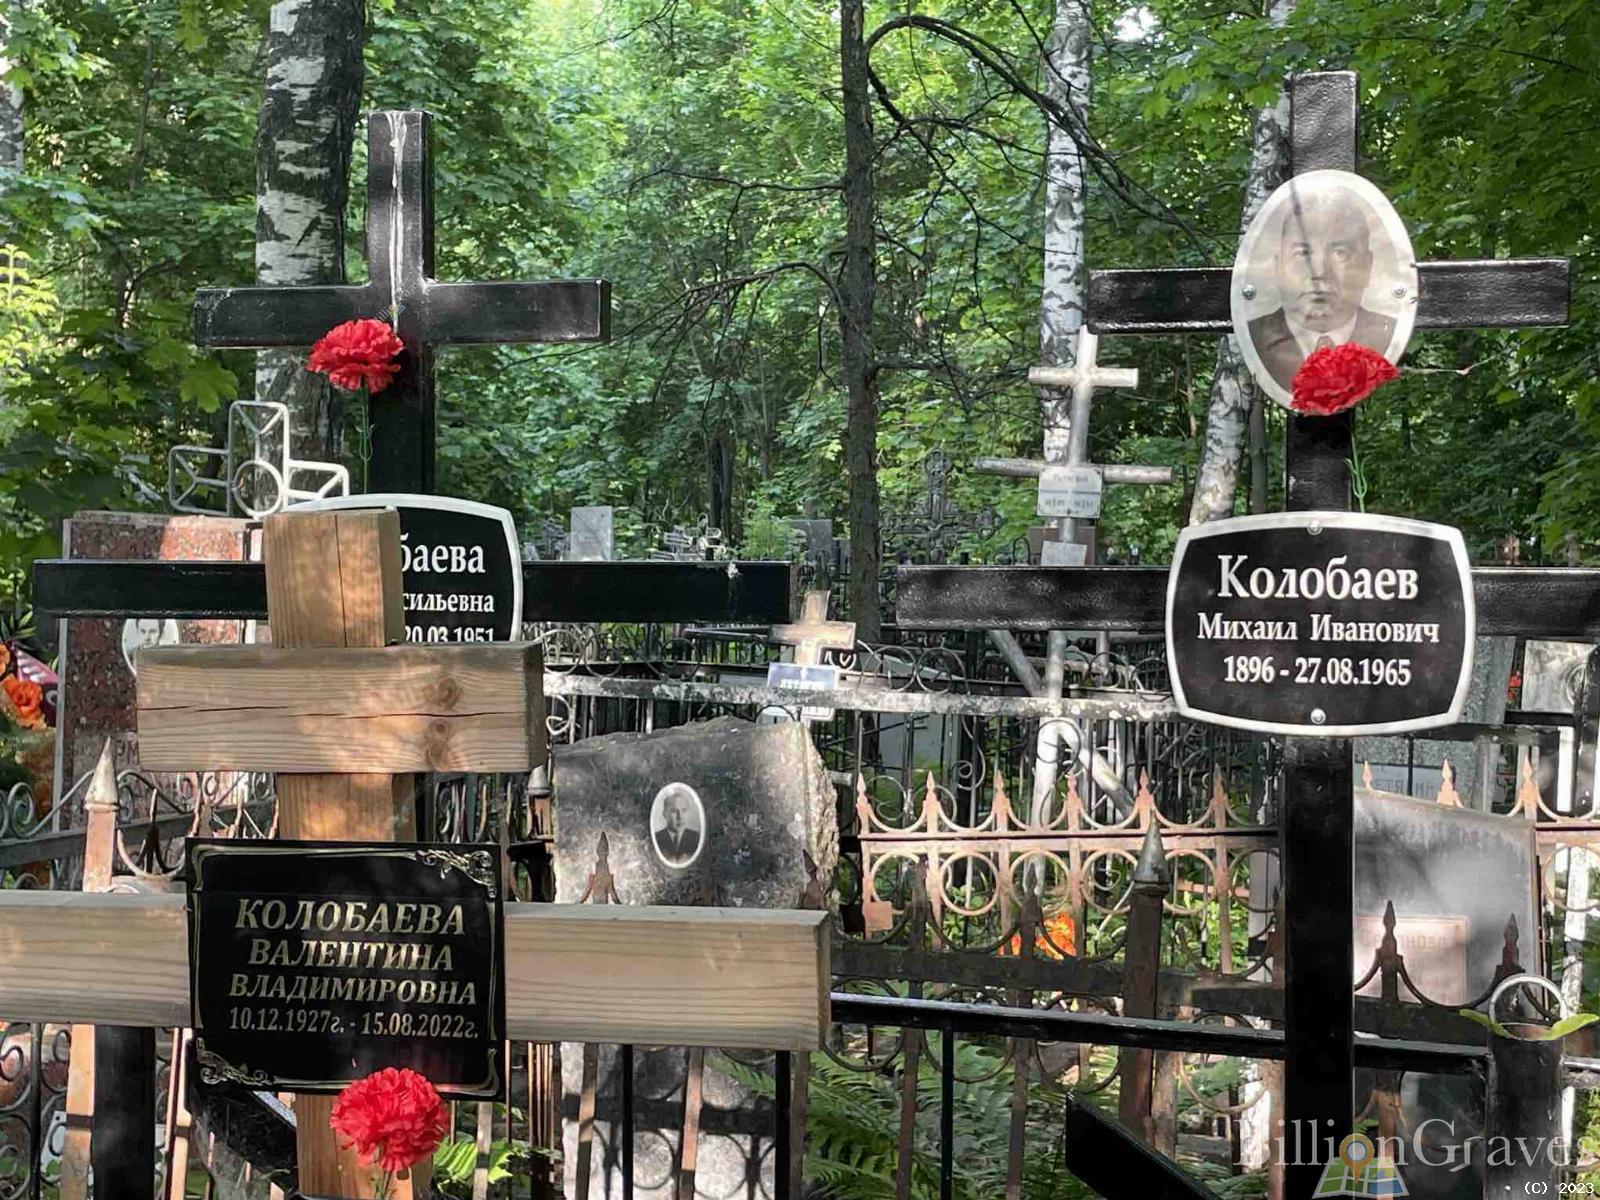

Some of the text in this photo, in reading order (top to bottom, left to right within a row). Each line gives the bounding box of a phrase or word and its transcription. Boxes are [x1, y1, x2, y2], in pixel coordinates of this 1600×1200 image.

[1217, 554, 1419, 600] Колобаев
[1197, 612, 1440, 643] Михаил Иванович
[1223, 655, 1274, 683] 1896
[1295, 657, 1412, 686] 27.08.1965
[234, 898, 466, 936] КОЛОБАЕВА
[248, 938, 453, 972] ВАЛЕНТИНА
[229, 973, 477, 1005] ВЛАДИМИРОВНА
[229, 1006, 344, 1034] 10.12.1927г.
[362, 1011, 479, 1040] 15.08.2022г.
